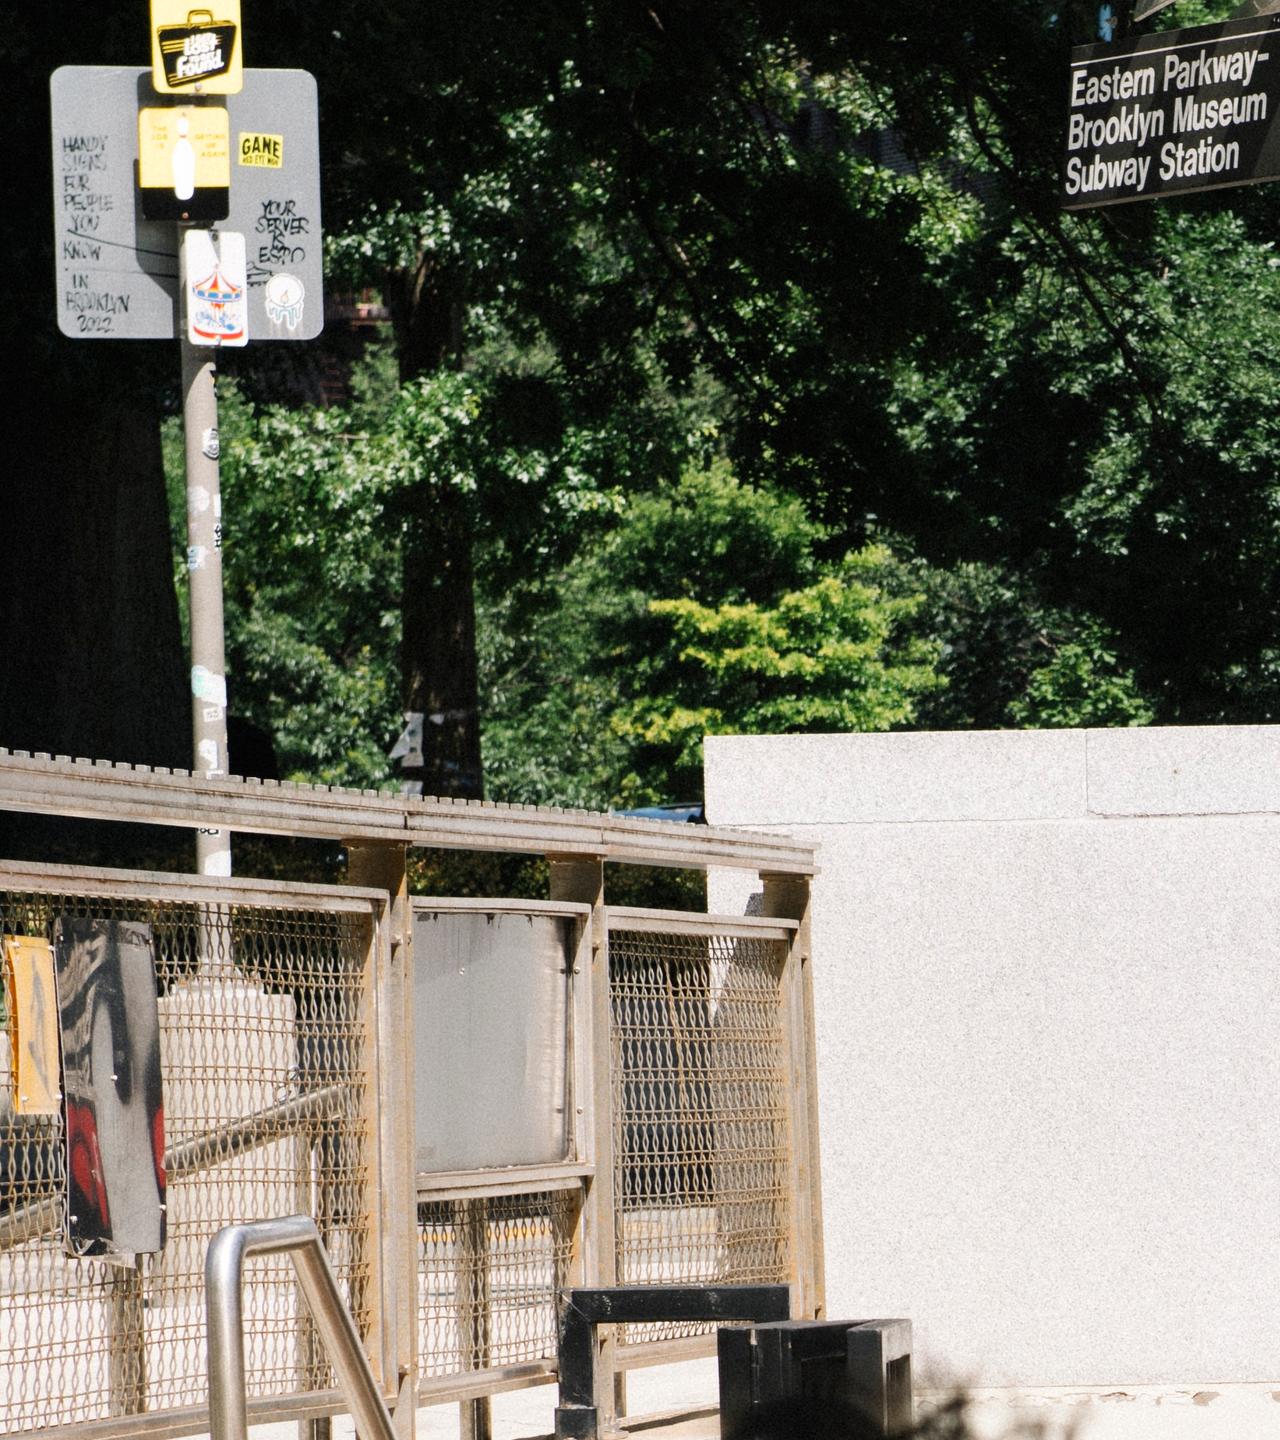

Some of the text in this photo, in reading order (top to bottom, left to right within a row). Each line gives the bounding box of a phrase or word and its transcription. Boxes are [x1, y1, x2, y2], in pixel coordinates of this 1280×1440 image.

[1071, 49, 1270, 107] Eastern Parkway-
[1068, 92, 1267, 150] Brooklyn Museum
[1065, 136, 1240, 195] Subway Station
[255, 216, 309, 235] SERVER
[262, 200, 296, 218] YOUR
[73, 273, 89, 290] IN
